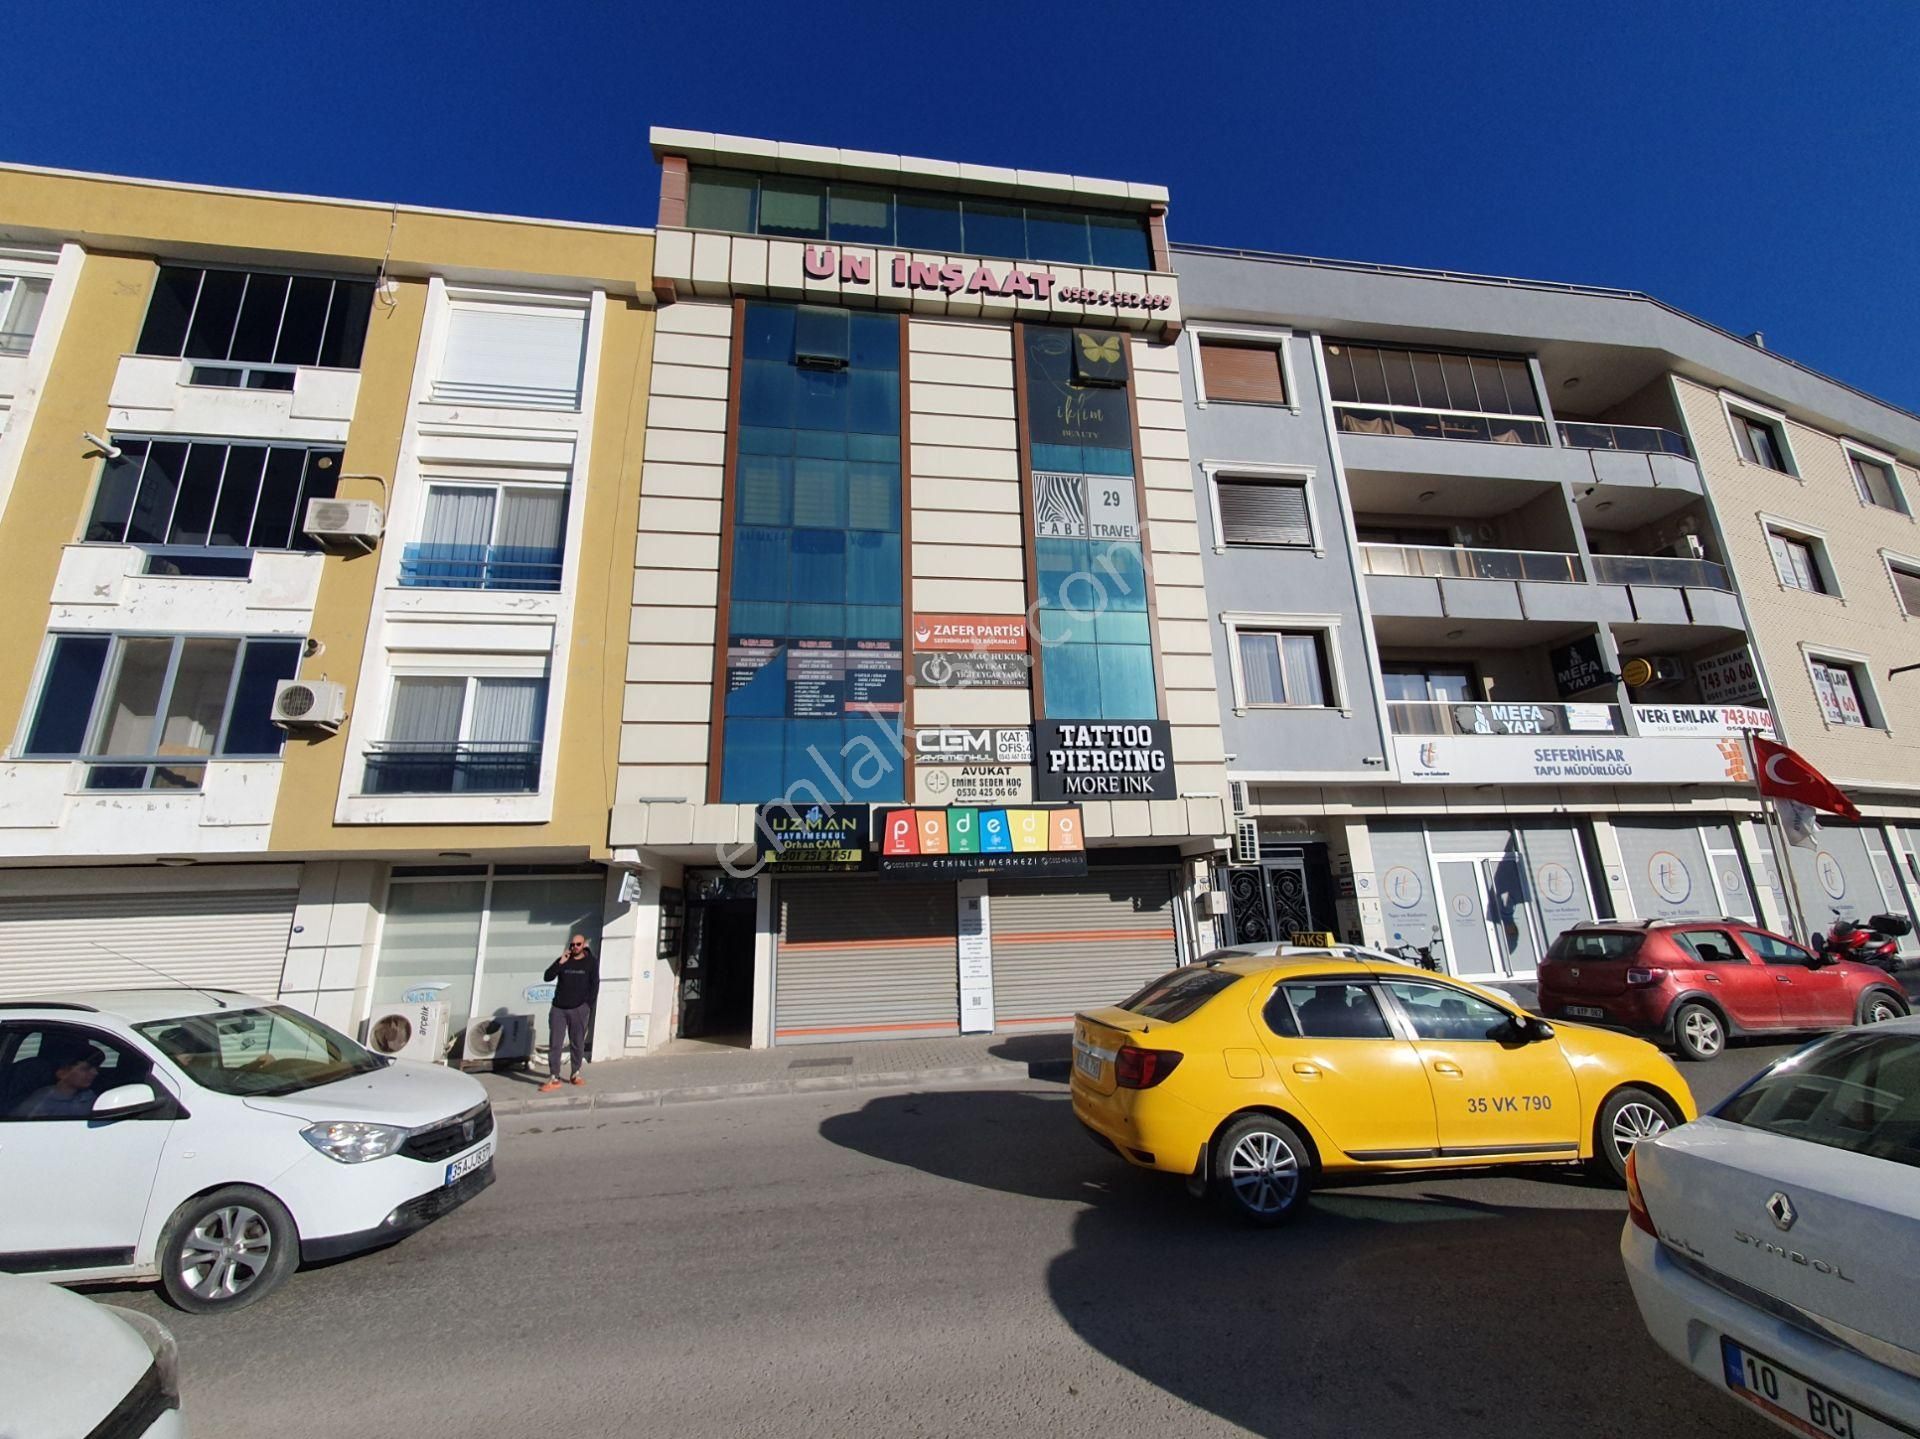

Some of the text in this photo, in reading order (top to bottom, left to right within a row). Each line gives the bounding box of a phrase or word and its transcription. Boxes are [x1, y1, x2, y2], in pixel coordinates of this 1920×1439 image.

[805, 245, 870, 283] ÜN
[891, 254, 1055, 299] İNŞAAT
[1059, 286, 1097, 304] 0532
[1112, 291, 1140, 307] 532
[1143, 293, 1172, 310] 999
[1103, 491, 1120, 506] 29
[1038, 522, 1086, 535] FABE
[1093, 523, 1136, 537] TRAVEL
[933, 624, 1025, 637] ZAFER PARTİSİ
[1558, 661, 1600, 683] MEFA
[1701, 662, 1753, 690] 743 60 60
[1567, 674, 1597, 690] YAPI
[1842, 696, 1856, 712] 60
[1491, 706, 1544, 720] MEFA
[1673, 709, 1719, 723] EMLAK
[1721, 709, 1745, 724] 743
[1746, 710, 1758, 726] 60
[1760, 711, 1772, 727] 60
[1503, 720, 1541, 733] YAPI
[1058, 725, 1153, 746] TATTOO
[1049, 750, 1166, 772] PIERCING
[1534, 746, 1625, 762] SEFERİHİSAR
[961, 767, 1011, 775] AVUKAT
[1534, 764, 1632, 776] TAPU MÜDÜRLÜĞÜ
[1006, 778, 1021, 788] KOÇ
[1066, 776, 1154, 792] MORE INK
[957, 788, 1018, 796] 0530 425 06 66
[773, 818, 856, 830] UZMAN
[816, 840, 841, 850] ÇAM
[840, 850, 852, 860] 51
[1468, 1095, 1552, 1112] 35 VK 790
[1733, 1229, 1855, 1284] SYMBOL
[1747, 1358, 1779, 1400] 10
